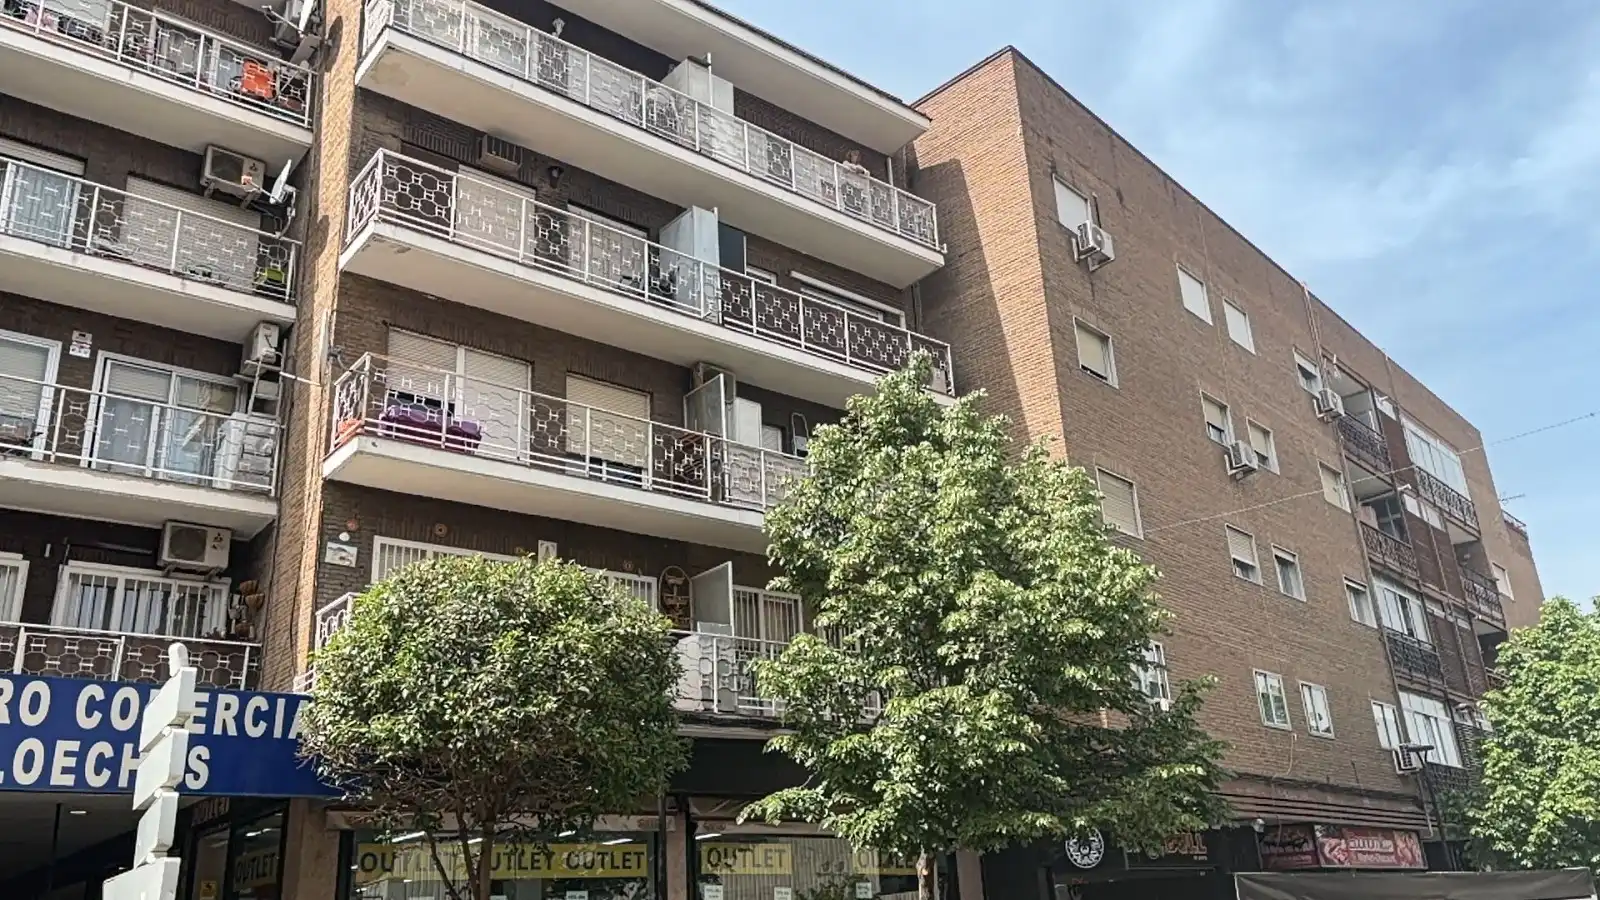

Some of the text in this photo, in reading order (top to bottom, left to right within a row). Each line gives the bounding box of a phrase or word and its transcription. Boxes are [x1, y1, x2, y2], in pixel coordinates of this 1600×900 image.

[0, 737, 211, 790] OECHS
[235, 852, 276, 882] OUTLET
[566, 851, 645, 871] OUTLET
[707, 847, 786, 869] OUTLET
